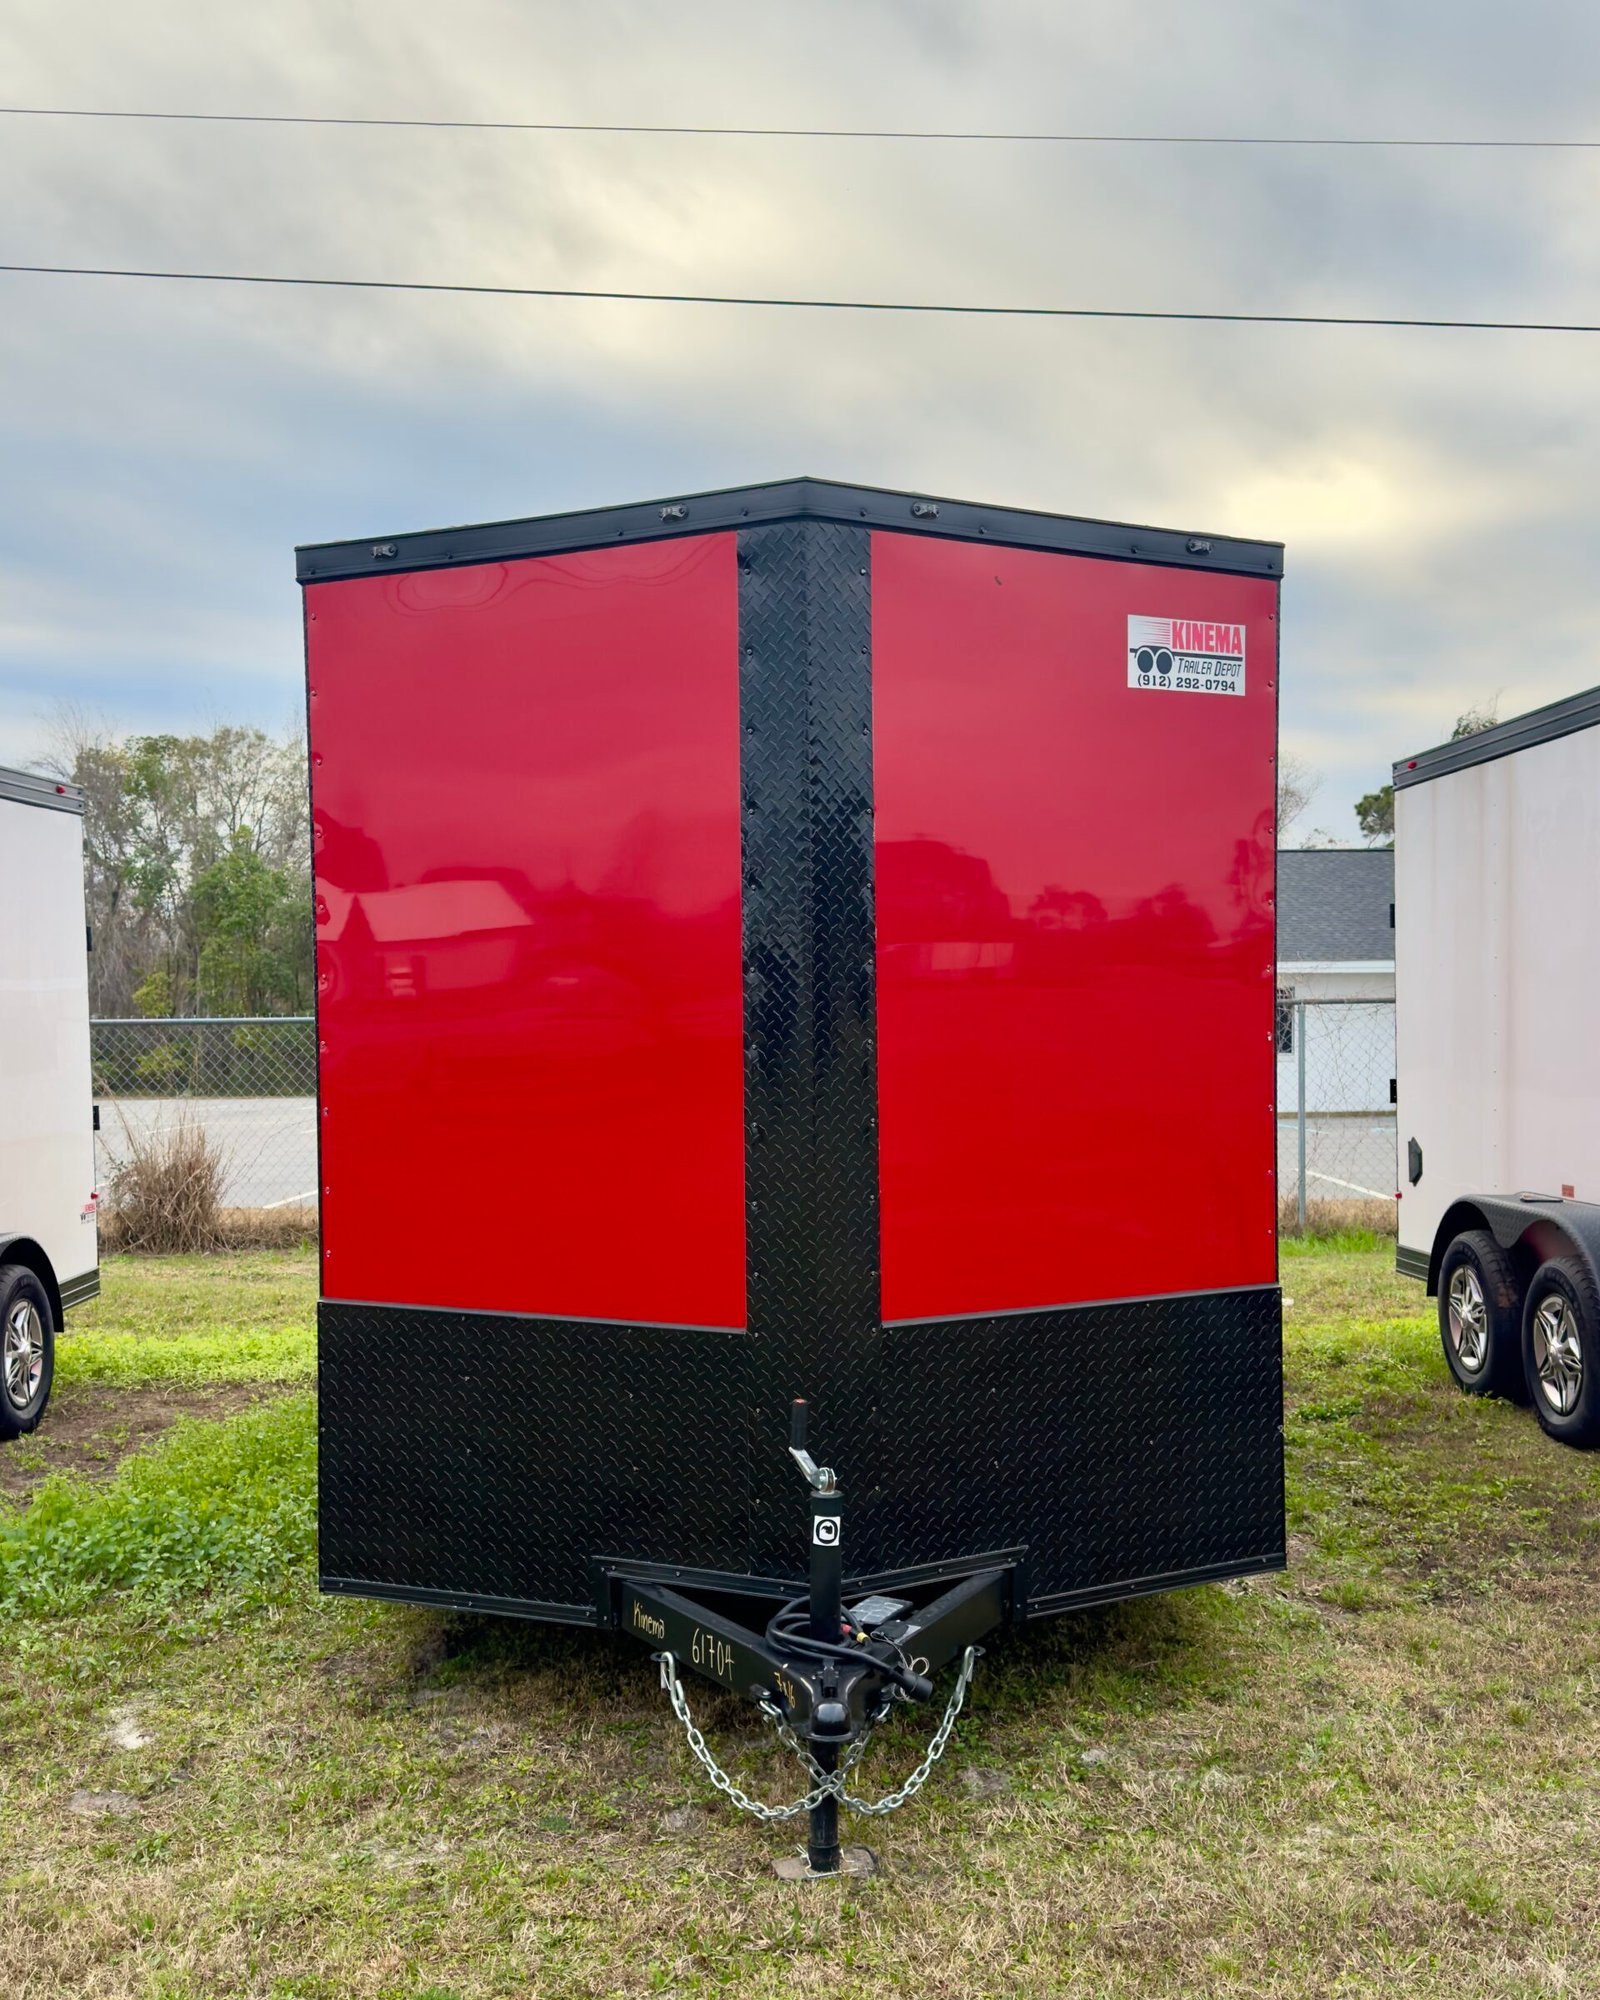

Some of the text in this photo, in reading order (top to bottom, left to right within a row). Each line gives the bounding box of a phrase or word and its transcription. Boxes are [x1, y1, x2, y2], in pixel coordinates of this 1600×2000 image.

[1171, 620, 1243, 655] KINEMA
[1137, 674, 1236, 692] (912) 292-0794
[1178, 658, 1242, 677] TRAILER DEPOT
[633, 1600, 665, 1639] Kinema
[692, 1628, 735, 1681] 61704
